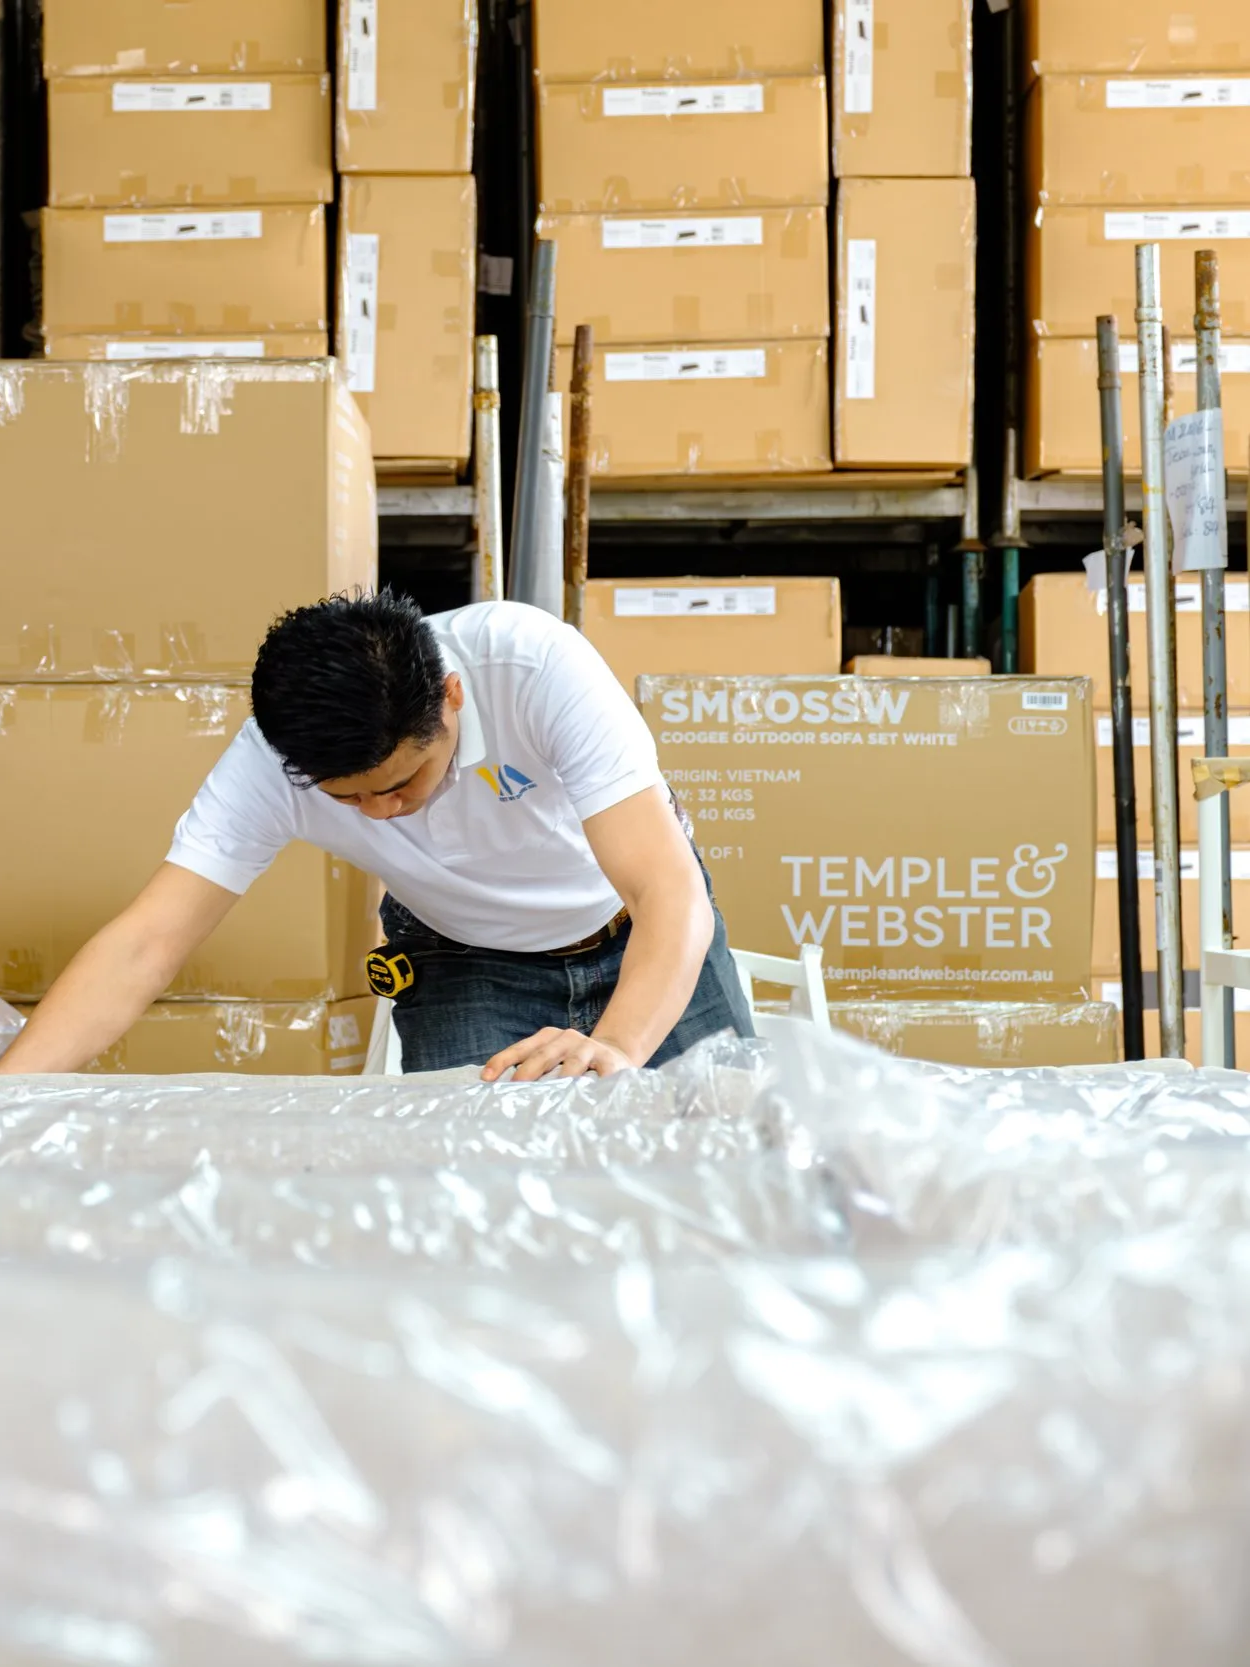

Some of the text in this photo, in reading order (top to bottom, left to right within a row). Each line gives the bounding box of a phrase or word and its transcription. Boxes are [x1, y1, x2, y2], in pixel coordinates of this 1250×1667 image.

[661, 689, 909, 725] SMCOSSW
[661, 731, 957, 746] COOGEE OUTDOOR SOFA SET WHITE
[661, 769, 801, 783] ORIGIN: VIETNAM
[697, 789, 717, 802] 32
[721, 789, 754, 802] KGS
[697, 808, 719, 821] 40
[723, 808, 756, 821] KGS
[710, 847, 733, 859] OF
[737, 847, 743, 859] 1
[780, 905, 1052, 948] WEBSTER
[822, 965, 1053, 983] .templeandwebster.com.au
